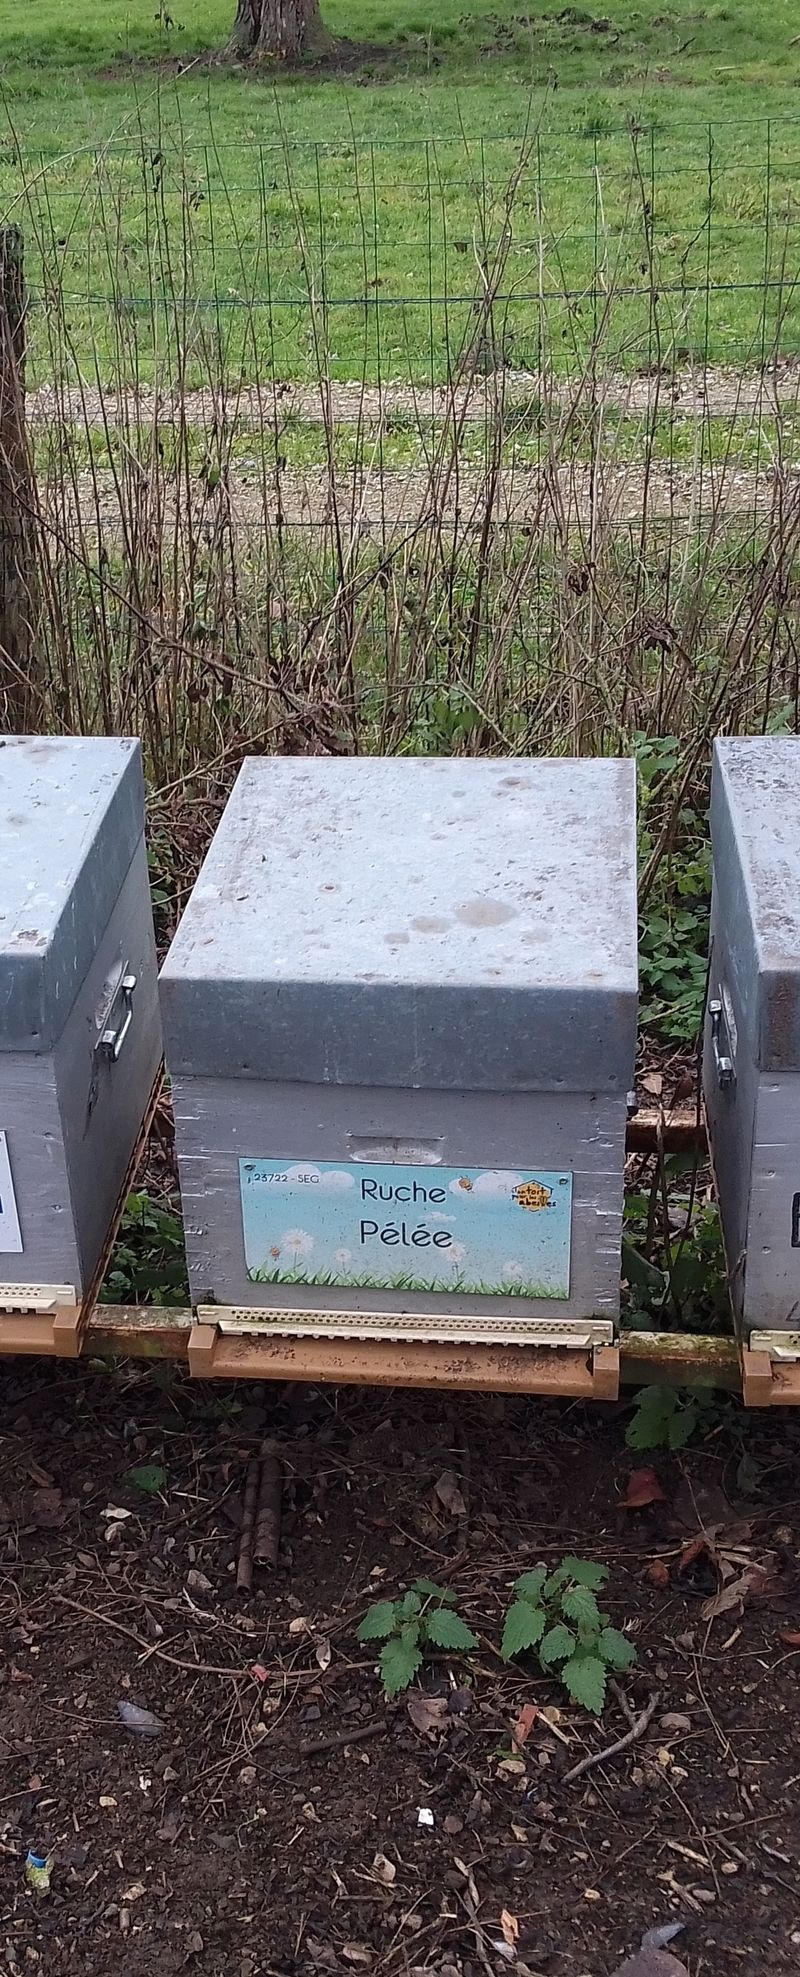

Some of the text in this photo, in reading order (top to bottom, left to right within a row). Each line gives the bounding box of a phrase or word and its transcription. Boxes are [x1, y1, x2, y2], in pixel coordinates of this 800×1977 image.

[254, 1173, 288, 1183] 23722
[297, 1174, 320, 1184] SEG
[361, 1178, 446, 1204] Ruche
[360, 1220, 453, 1248] Pélée
